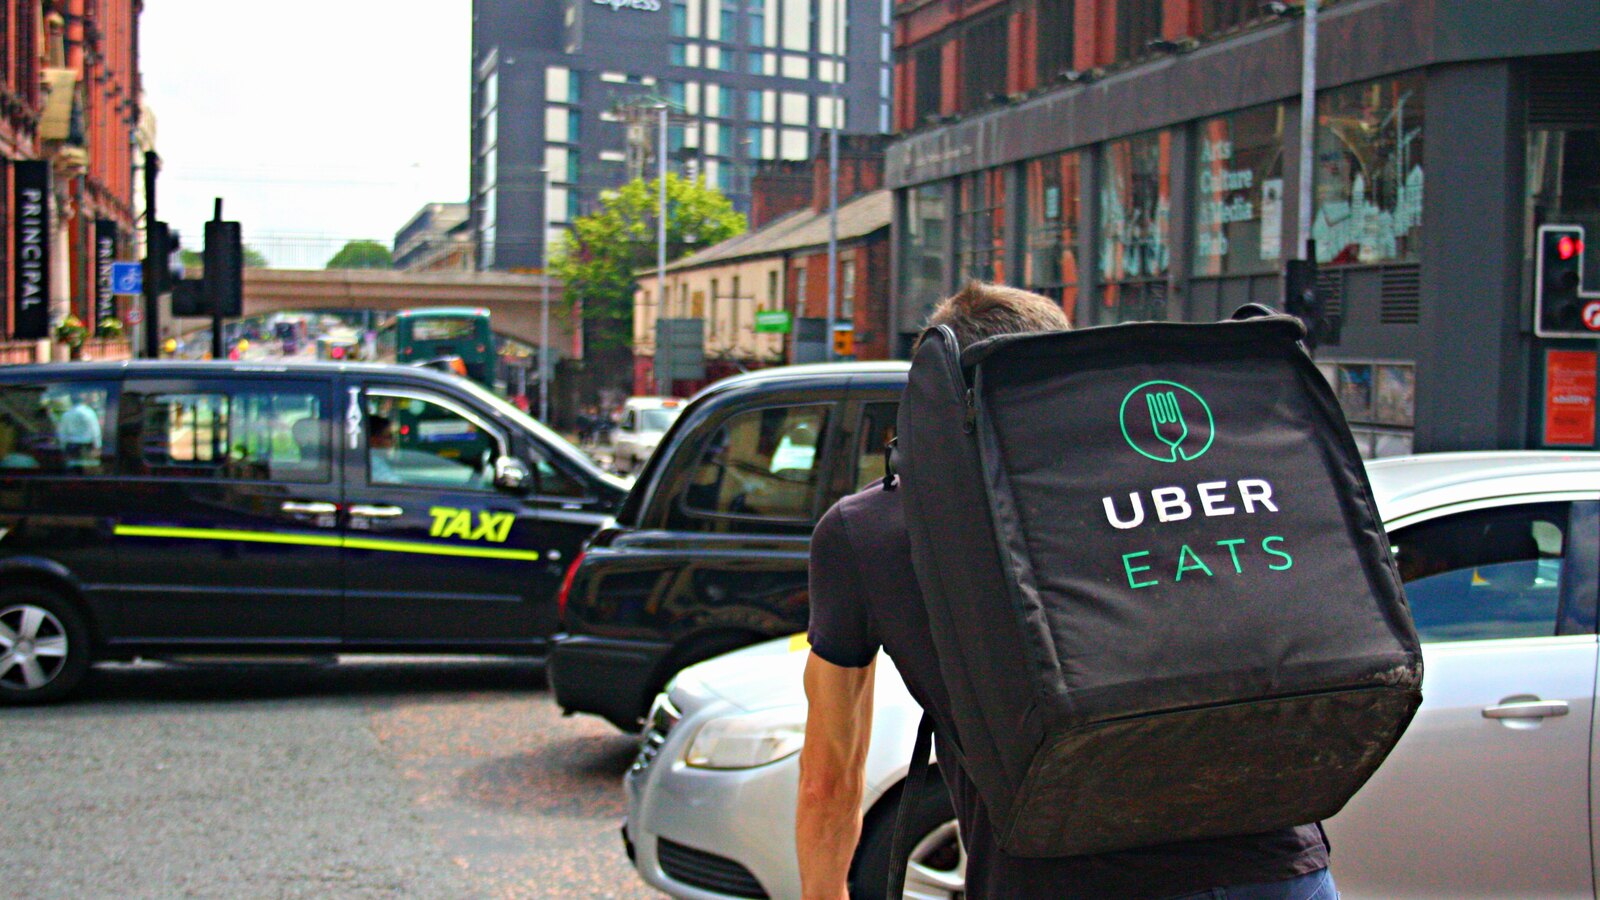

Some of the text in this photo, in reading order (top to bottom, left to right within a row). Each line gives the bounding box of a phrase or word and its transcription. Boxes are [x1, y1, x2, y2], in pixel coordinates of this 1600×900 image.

[1200, 169, 1253, 193] Culture
[22, 188, 42, 311] PRINCIPAL
[99, 236, 113, 317] PRINCIPAL
[430, 506, 515, 543] TAXI
[1102, 479, 1279, 530] UBER
[1122, 535, 1294, 589] EATS
